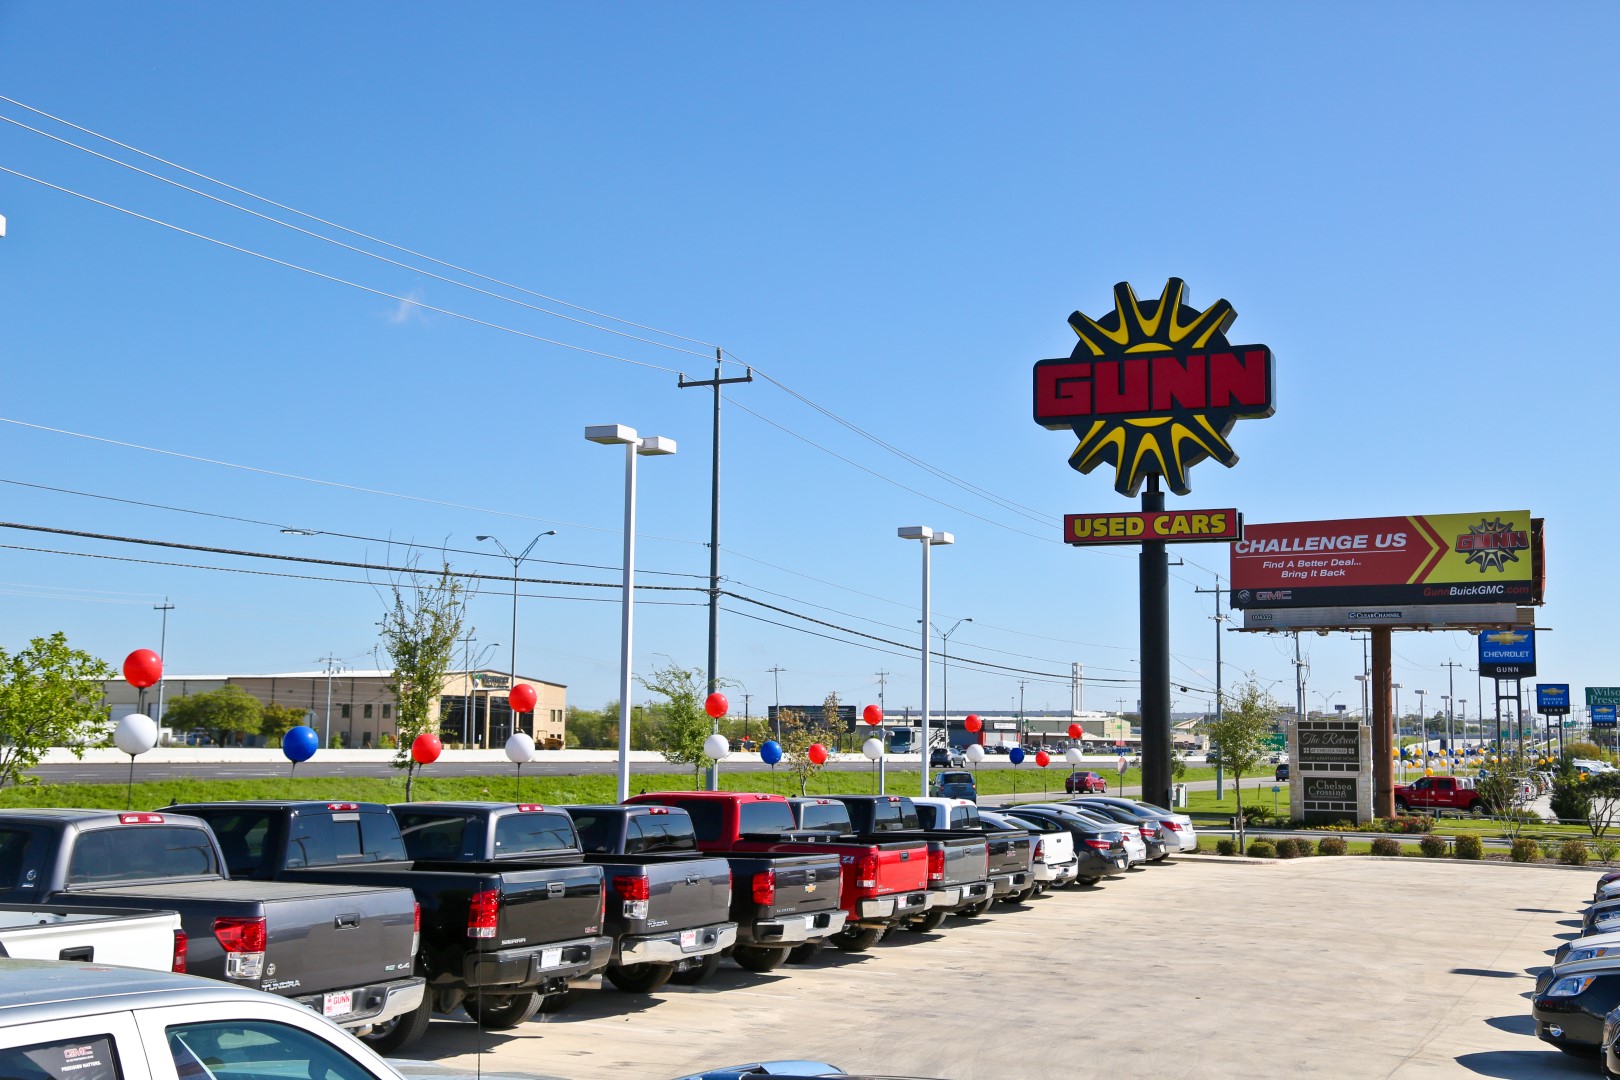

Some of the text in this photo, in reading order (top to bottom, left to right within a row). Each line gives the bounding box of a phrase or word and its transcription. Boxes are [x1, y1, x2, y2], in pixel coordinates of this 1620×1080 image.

[1037, 350, 1266, 417] GUNN
[1074, 513, 1227, 538] USED CARS
[1234, 532, 1408, 554] CHALLENGE US
[1456, 531, 1529, 551] GUNN
[1263, 558, 1362, 569] Find A Better Deal...
[1281, 568, 1346, 579] Bring It Back
[1256, 590, 1292, 601] GMC
[1299, 732, 1359, 745] The Retreat
[1316, 780, 1352, 790] Chelsea
[1309, 786, 1346, 798] Crossing
[261, 980, 301, 991] TUNDRA
[333, 995, 351, 1005] GUNN
[64, 1046, 93, 1058] GMC
